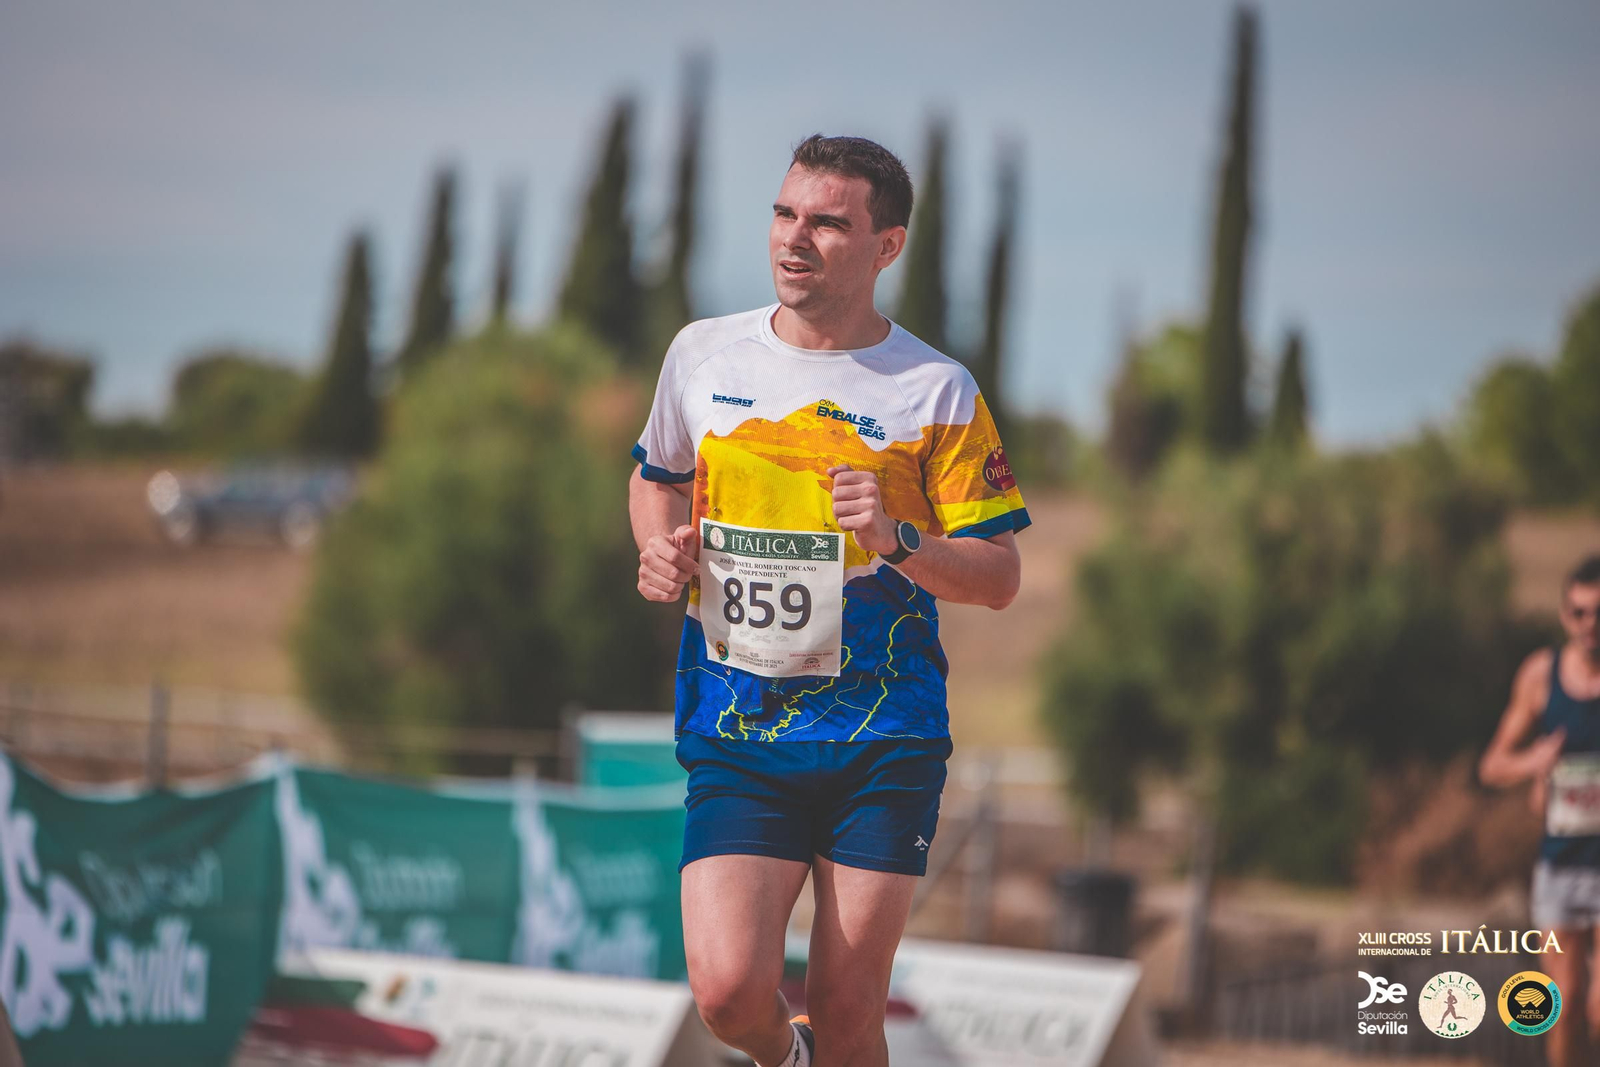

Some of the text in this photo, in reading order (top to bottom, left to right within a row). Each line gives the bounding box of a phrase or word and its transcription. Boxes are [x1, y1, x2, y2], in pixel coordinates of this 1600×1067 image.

[816, 405, 877, 429] EMBALSE
[858, 426, 886, 441] BEAS
[985, 463, 1012, 481] OBE
[731, 533, 799, 555] ITÁLICA
[739, 569, 788, 578] INDEPENDIENTE
[754, 562, 783, 571] ROMERO
[784, 565, 817, 573] TOSCANO
[723, 577, 812, 631] 859
